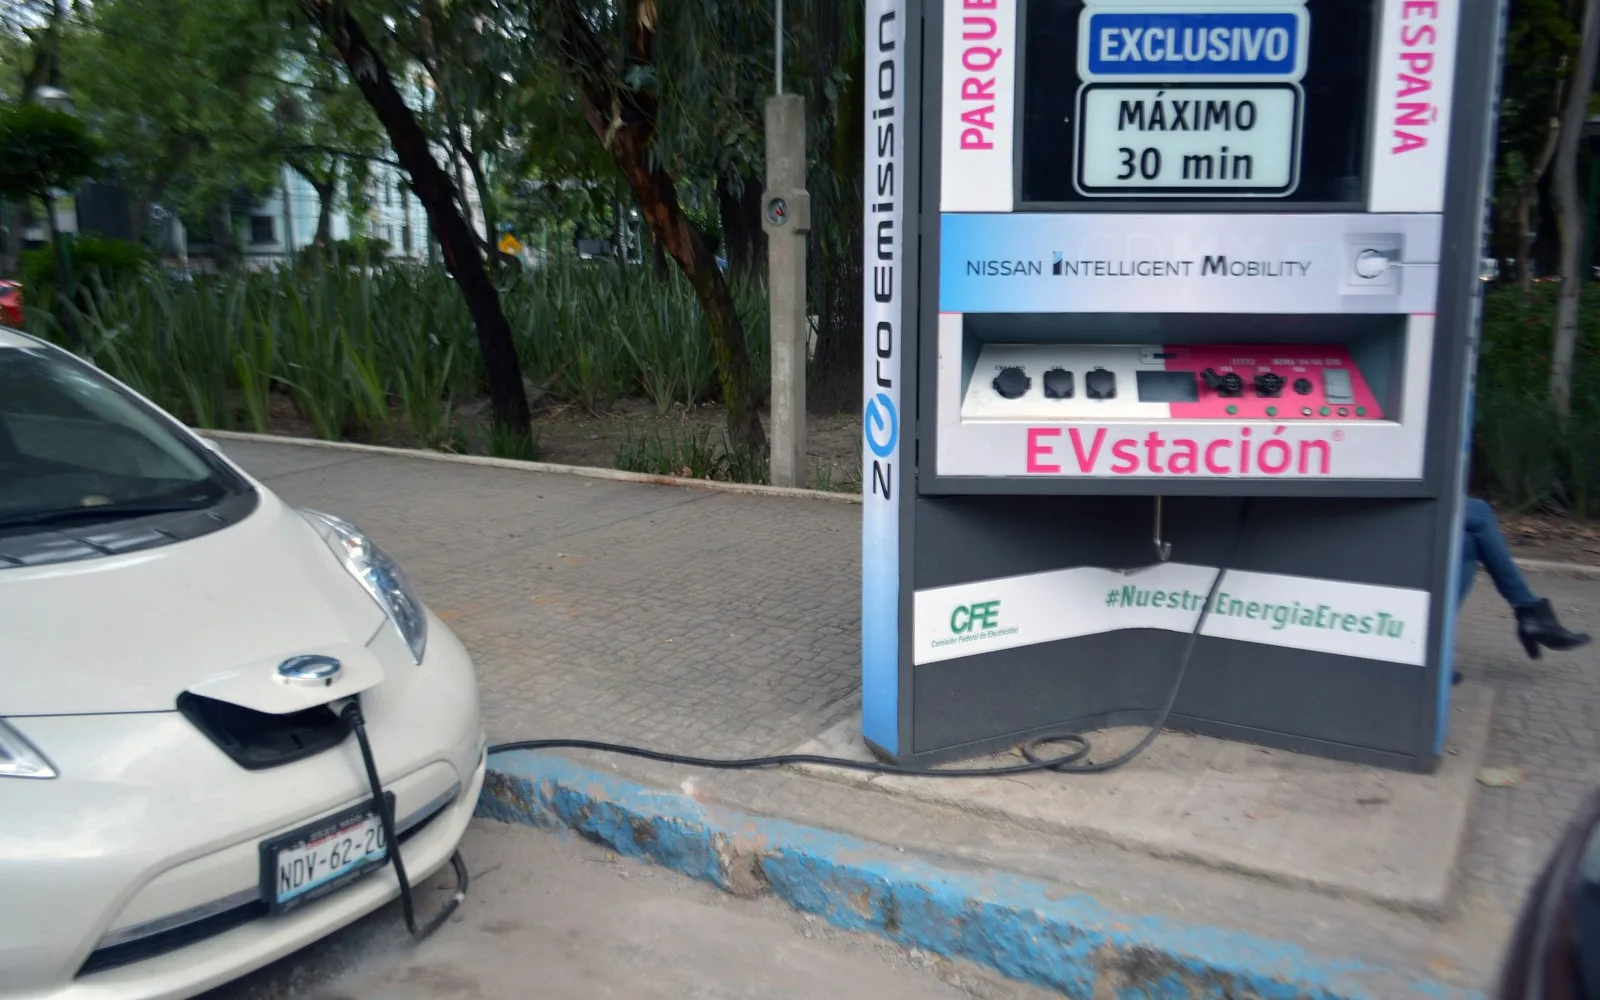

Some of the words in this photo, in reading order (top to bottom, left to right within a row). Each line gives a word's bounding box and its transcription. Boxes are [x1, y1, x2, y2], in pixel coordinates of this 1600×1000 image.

[1099, 27, 1289, 62] EXCLUSIVO
[960, 0, 1002, 150] PARQUE
[1391, 1, 1438, 155] ESPAÑA
[1117, 90, 1257, 131] MÁXIMO
[1117, 147, 1162, 180] 30
[1182, 146, 1253, 180] min
[967, 260, 1042, 276] NISSAN
[950, 600, 1001, 634] CFE
